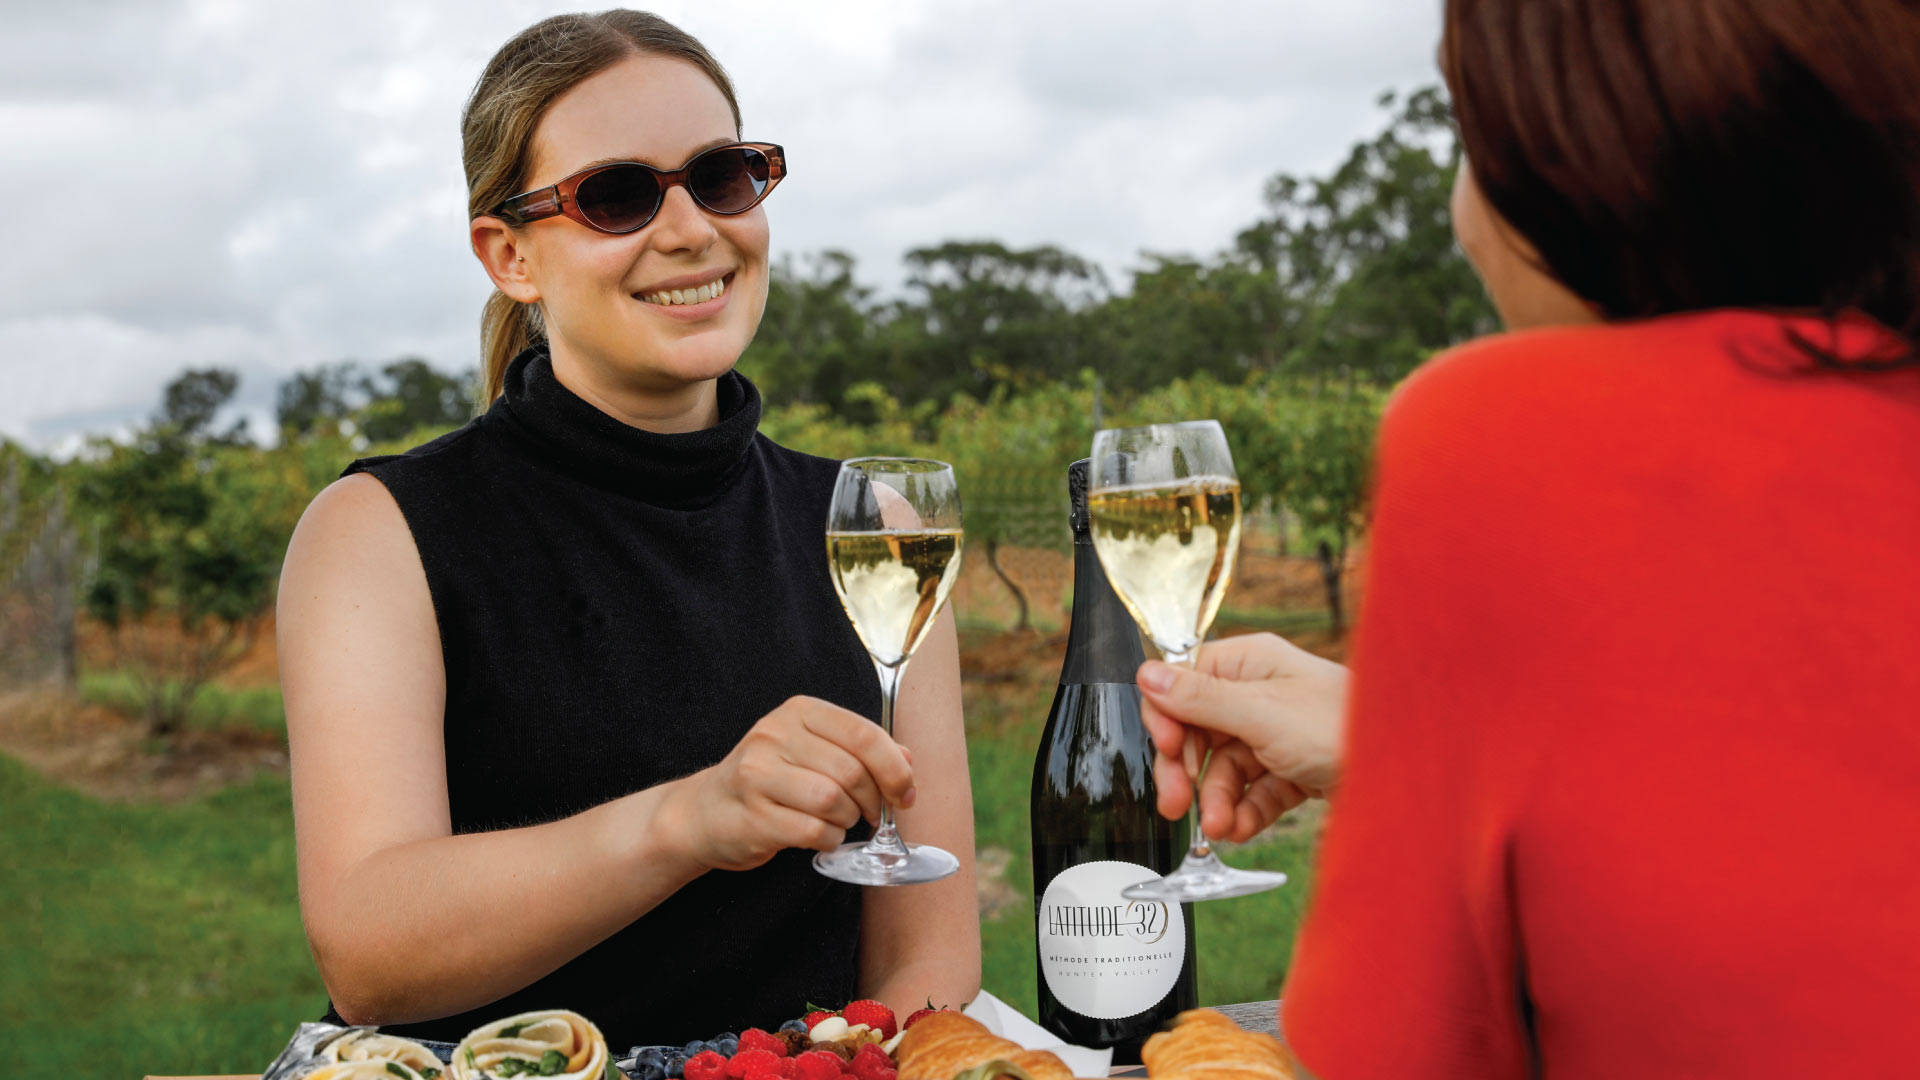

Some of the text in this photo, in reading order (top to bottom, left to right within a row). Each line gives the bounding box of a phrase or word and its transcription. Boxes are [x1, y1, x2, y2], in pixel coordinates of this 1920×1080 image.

[1049, 903, 1157, 936] LATITUDE 32
[1095, 952, 1173, 964] TRADITIONELLE
[1058, 968, 1159, 978] HUNTER VALLEY
